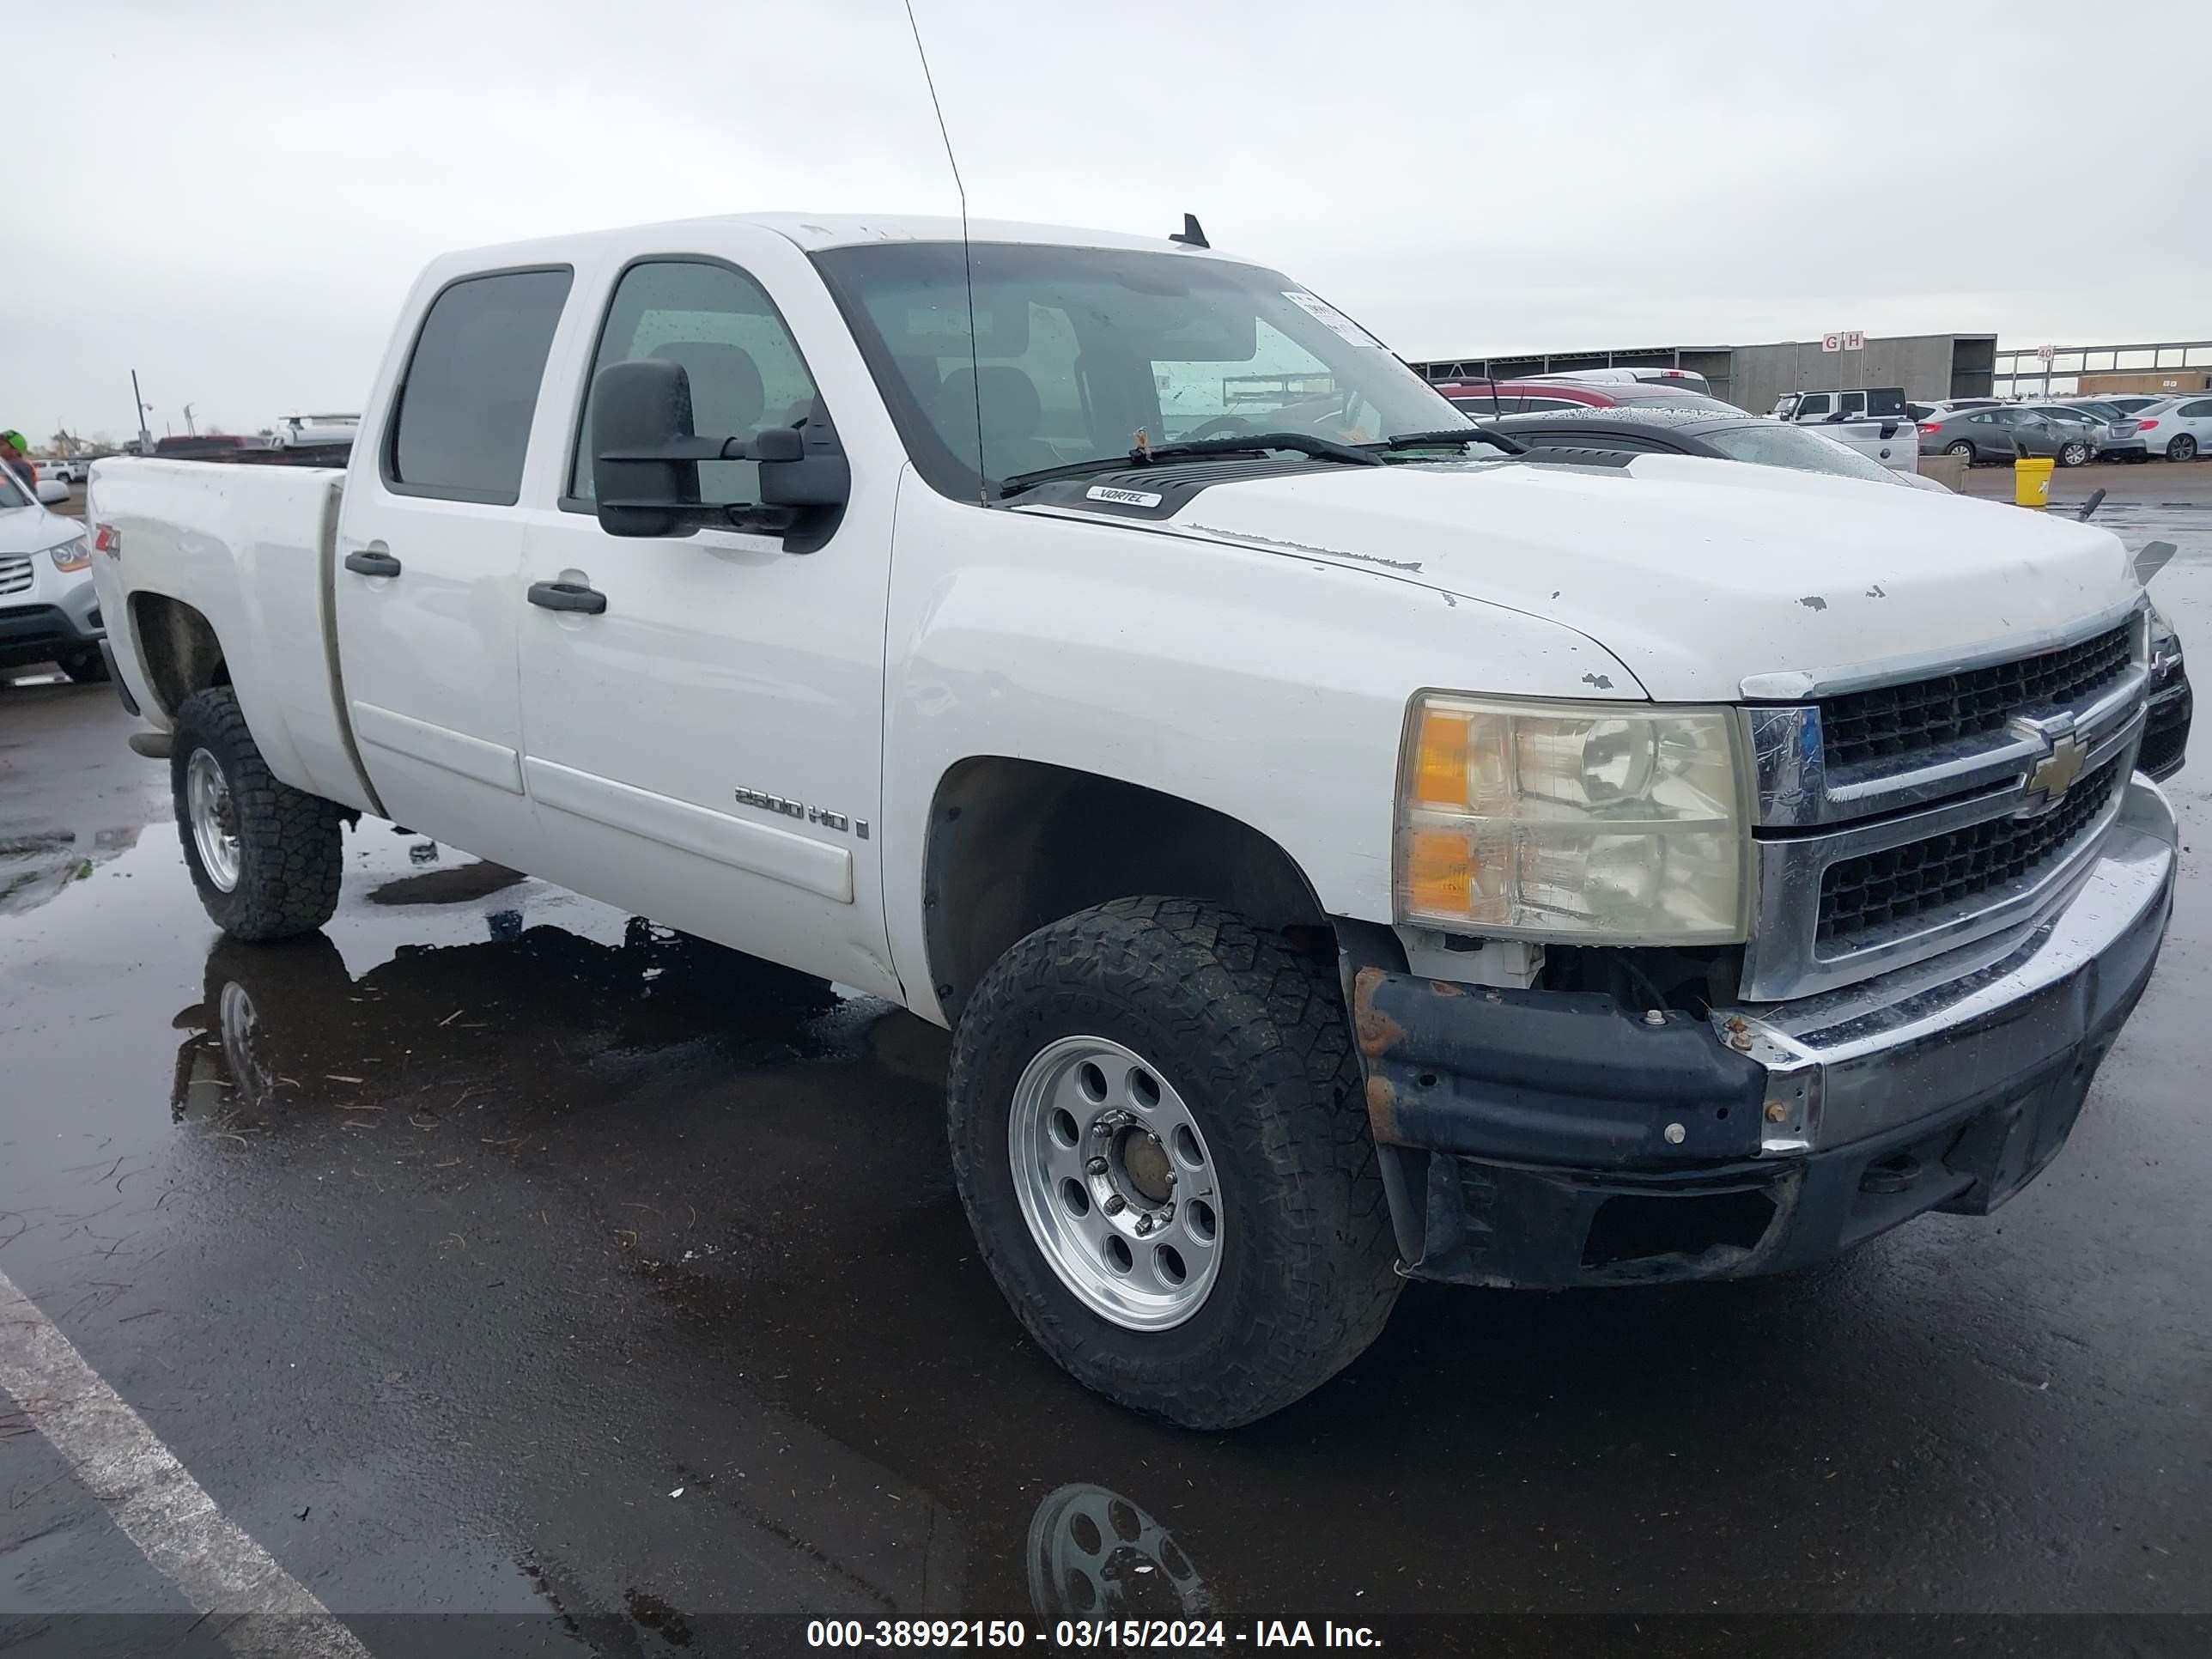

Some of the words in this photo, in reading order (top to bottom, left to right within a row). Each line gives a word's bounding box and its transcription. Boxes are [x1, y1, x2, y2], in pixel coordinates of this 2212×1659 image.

[1826, 336, 1838, 349] G
[1849, 333, 1860, 347] H
[2039, 349, 2051, 359] 40
[1100, 489, 1149, 503] VORTEC
[807, 805, 849, 832] HD
